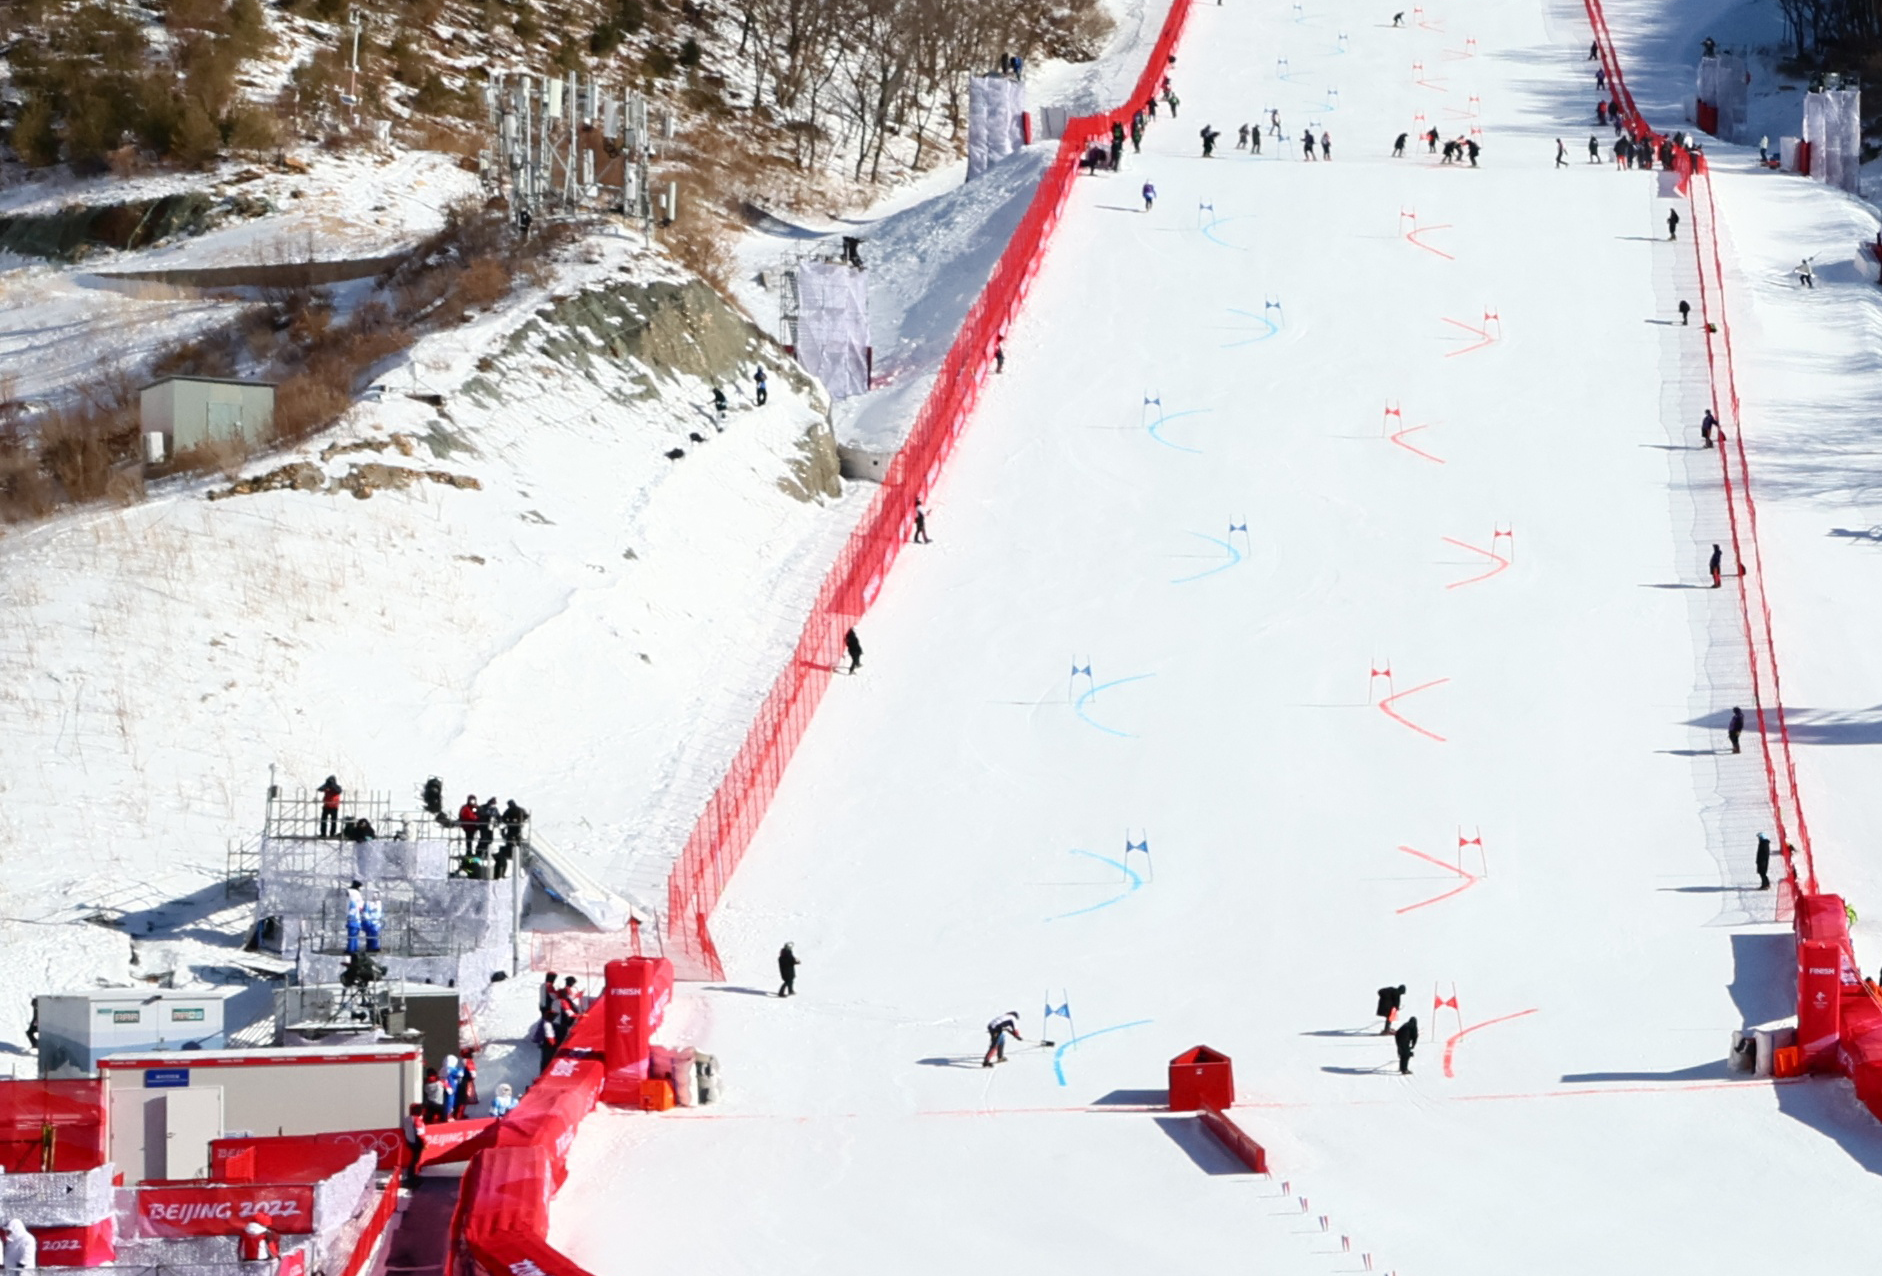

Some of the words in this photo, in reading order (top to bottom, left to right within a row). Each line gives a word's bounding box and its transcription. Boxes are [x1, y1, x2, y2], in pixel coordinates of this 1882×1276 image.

[611, 988, 641, 996] FINISH
[149, 1202, 231, 1224] BEIJING
[238, 1200, 302, 1217] 2022
[42, 1240, 81, 1250] 2022
